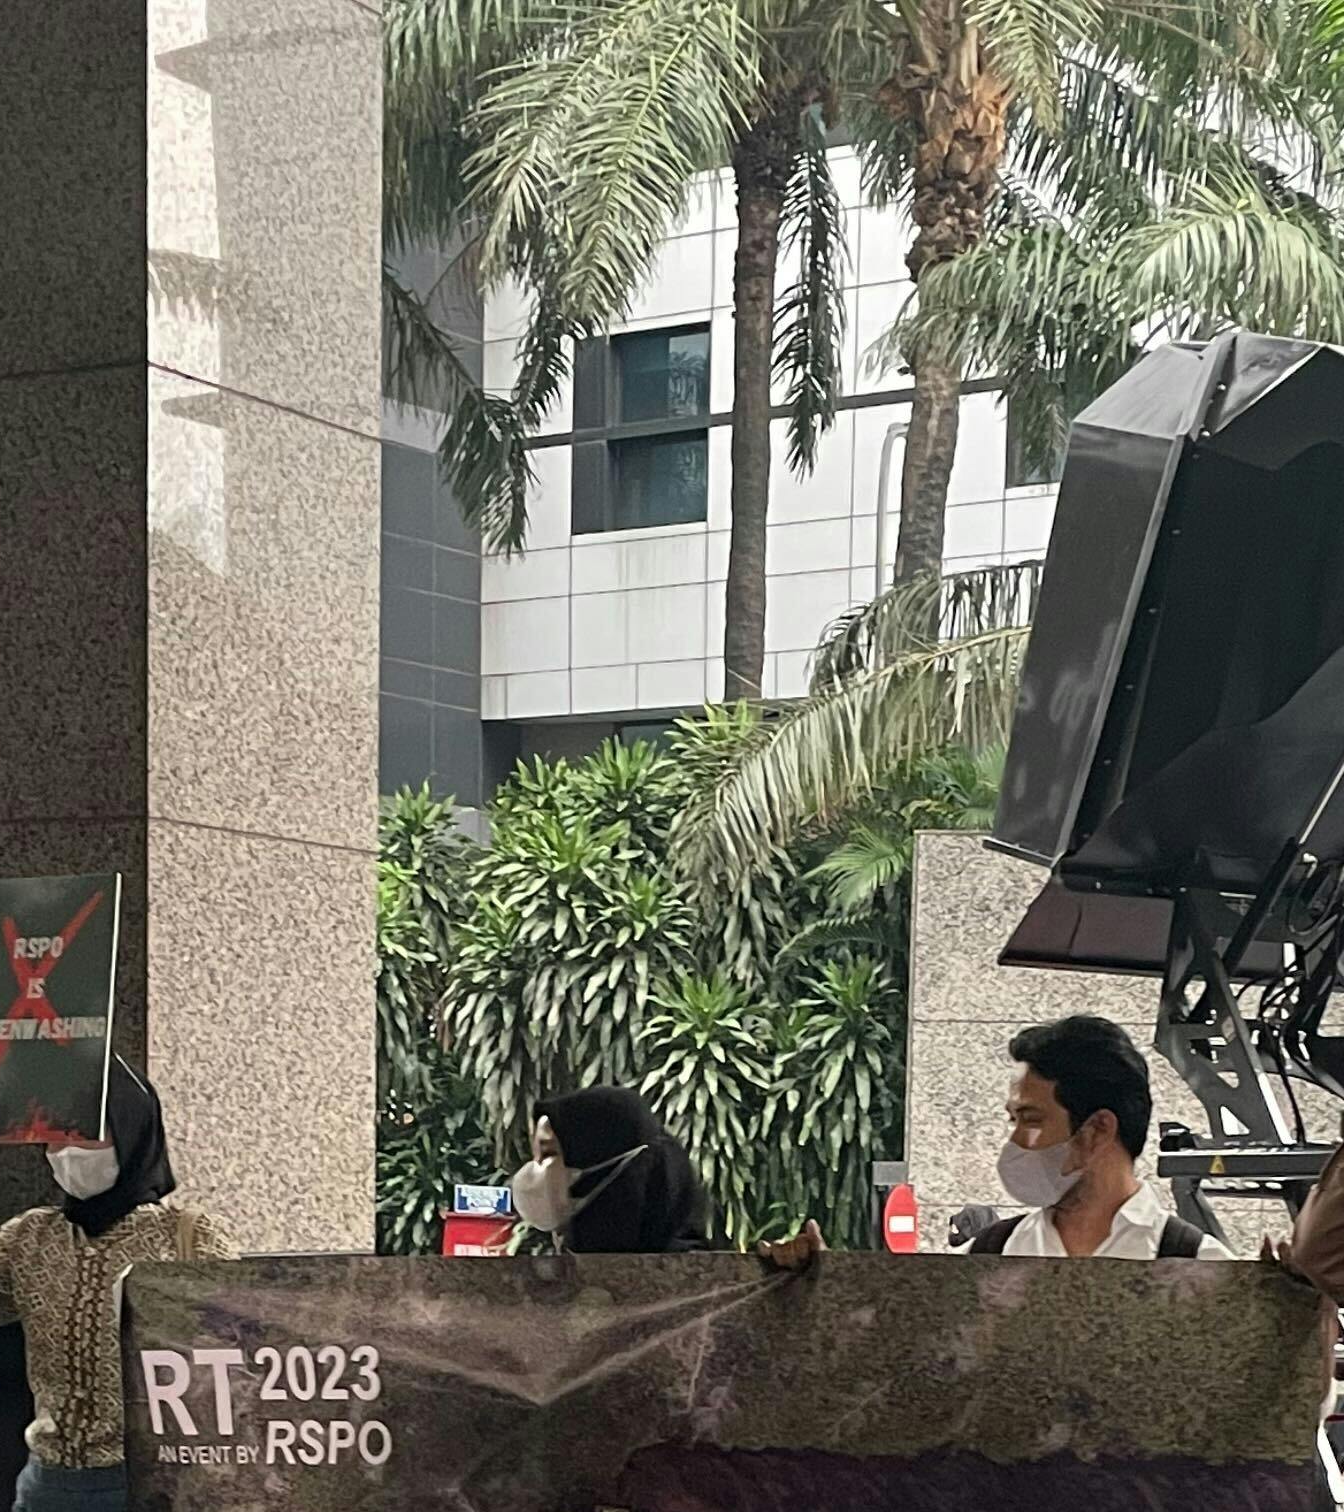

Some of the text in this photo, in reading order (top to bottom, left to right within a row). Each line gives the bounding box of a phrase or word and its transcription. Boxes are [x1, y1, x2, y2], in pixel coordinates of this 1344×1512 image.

[14, 935, 64, 960] RSPO
[26, 977, 46, 999] IS
[141, 1345, 382, 1436] RT 2023
[178, 1445, 233, 1465] EVENT
[236, 1444, 260, 1465] BY
[265, 1420, 394, 1466] RSPO
